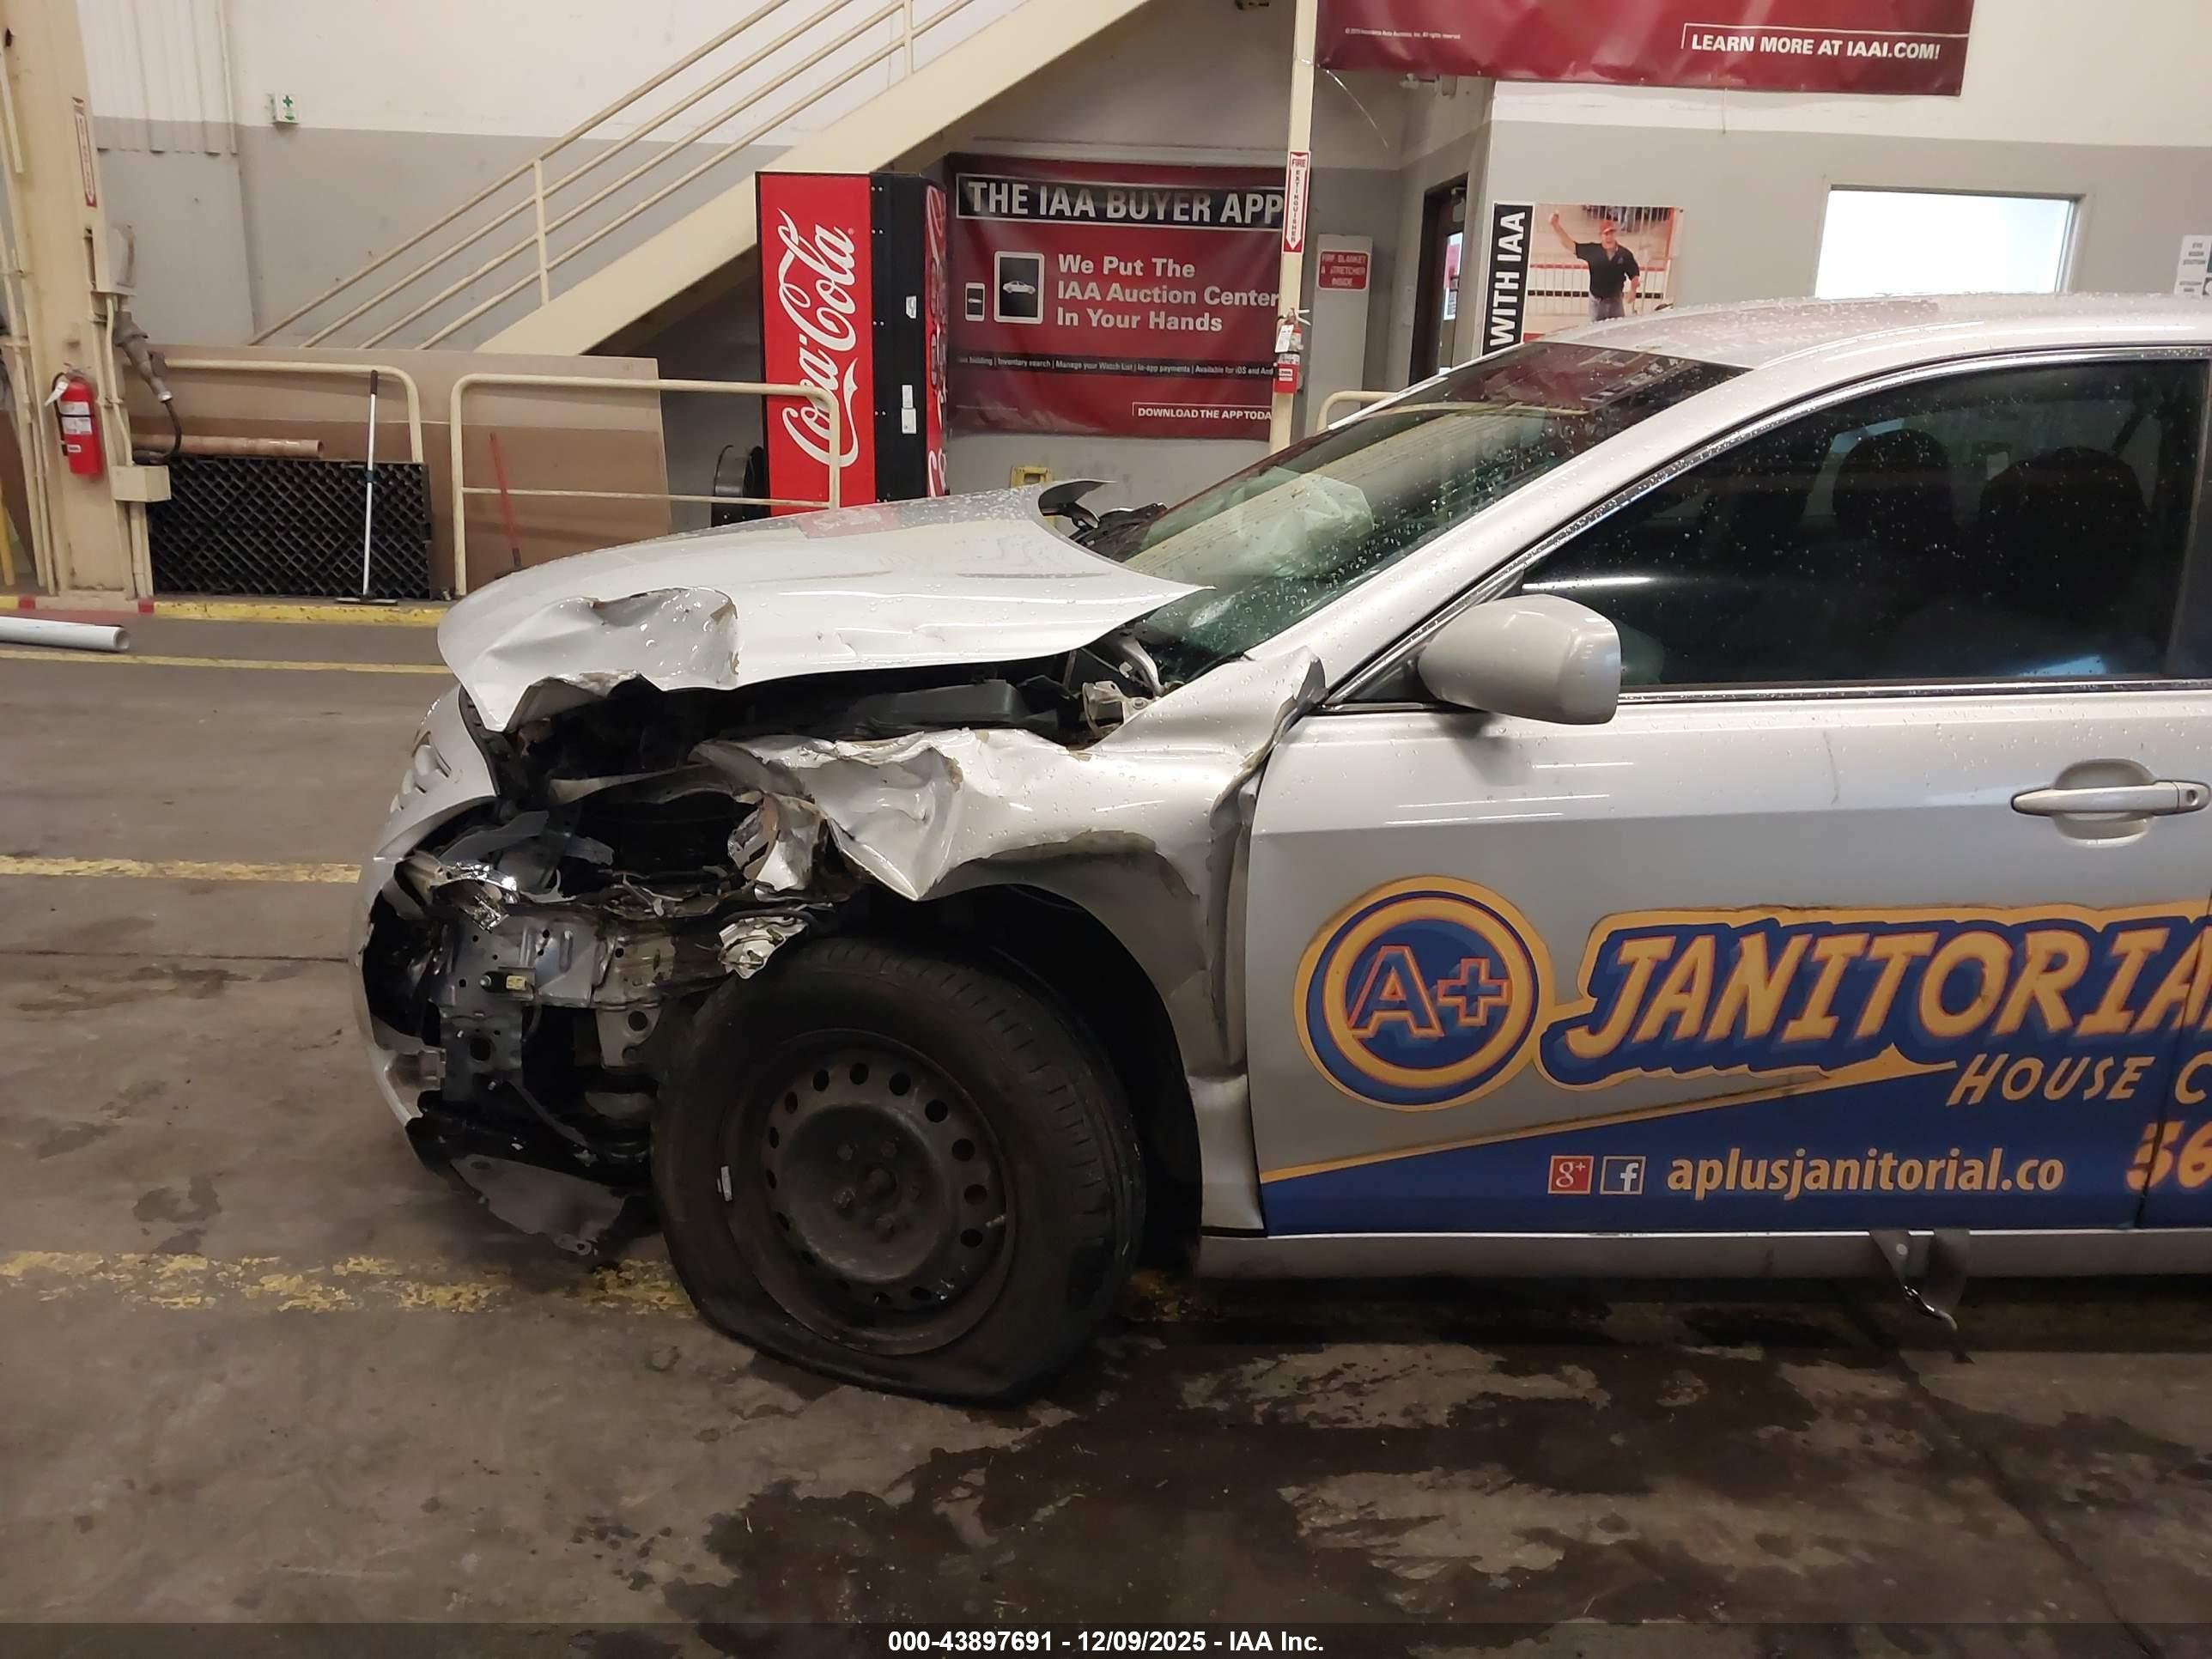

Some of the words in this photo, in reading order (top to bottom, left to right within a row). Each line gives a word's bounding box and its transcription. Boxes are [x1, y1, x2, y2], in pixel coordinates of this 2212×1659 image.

[1692, 33, 1754, 52] LEARN
[1759, 36, 1814, 55] MORE
[1817, 40, 1843, 56] AT
[1846, 40, 1941, 60] IAAI.COM!
[967, 181, 1029, 215] THE
[1039, 185, 1096, 218] IAA
[1106, 189, 1211, 222] BUYER
[1219, 193, 1284, 224] APP
[1497, 211, 1526, 263] IAA
[1057, 253, 1094, 275] We
[1103, 256, 1144, 276] Put
[1152, 258, 1195, 278] The
[1057, 281, 1102, 301] IAA
[1106, 283, 1196, 304] Auction
[1204, 286, 1279, 307] Center
[1490, 271, 1520, 347] WITH
[1057, 307, 1079, 326] In
[1086, 307, 1140, 330] Your
[1149, 311, 1223, 331] Hands
[998, 357, 1028, 368] Inventory
[1260, 366, 1273, 375] And
[1138, 407, 1199, 418] DOWNLOAD
[1200, 409, 1219, 419] THE
[1221, 410, 1244, 420] APP
[1244, 410, 1272, 420] TODA
[1347, 944, 1510, 1039] A+
[1565, 926, 2212, 1060] JANITORIA
[1945, 1053, 2156, 1108] HOUSE
[1666, 1146, 2064, 1201] aplusjanitorial.co
